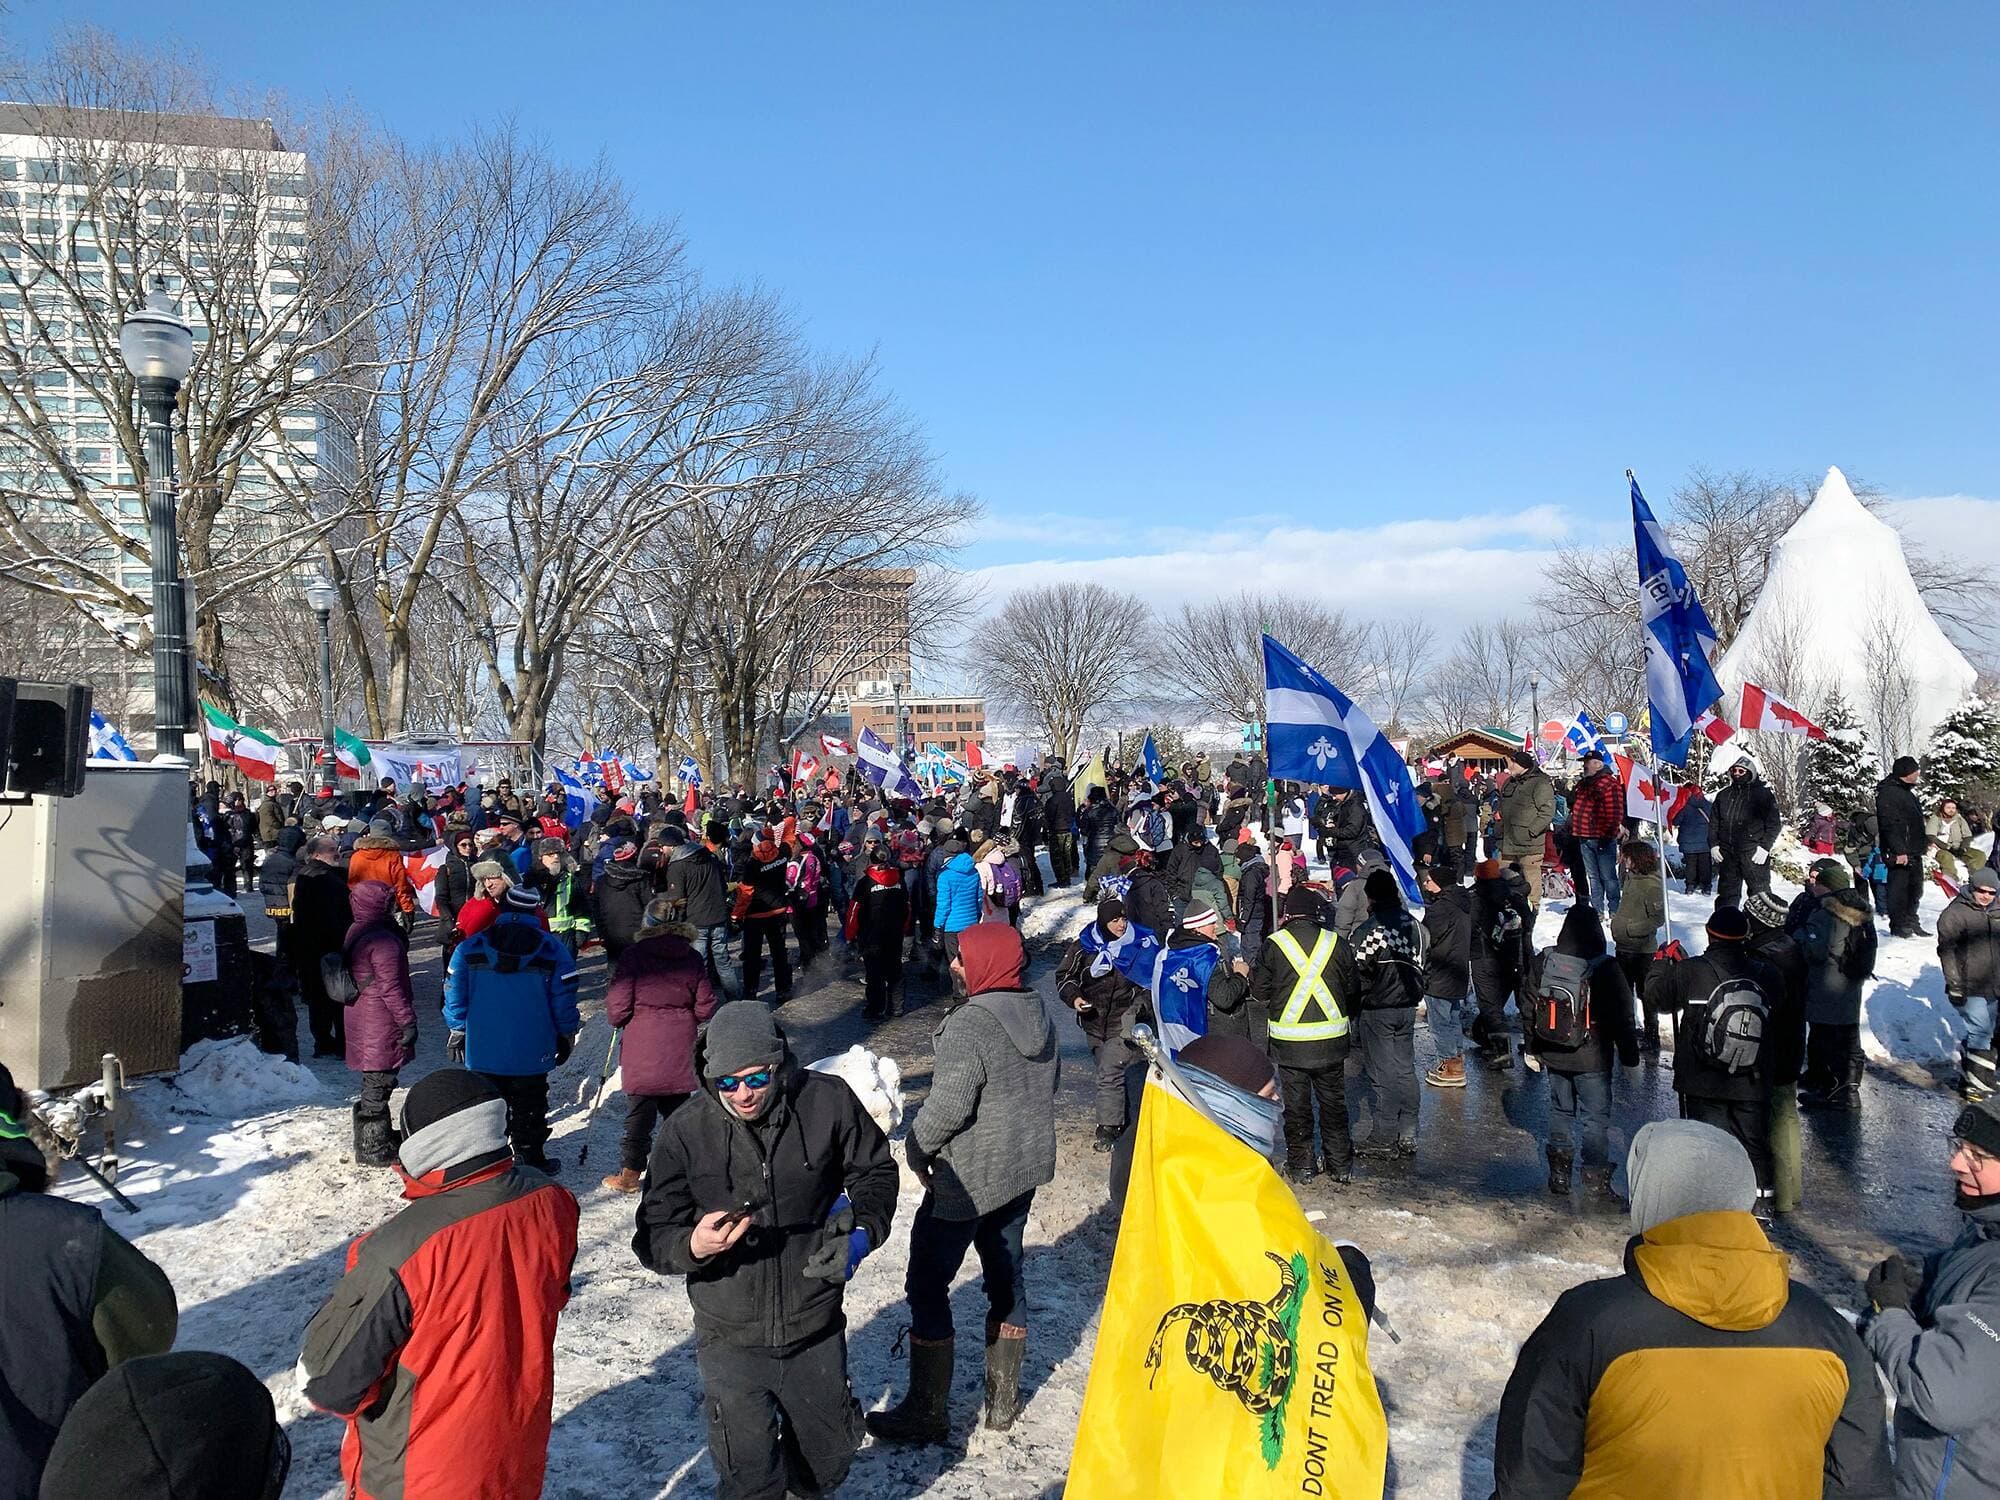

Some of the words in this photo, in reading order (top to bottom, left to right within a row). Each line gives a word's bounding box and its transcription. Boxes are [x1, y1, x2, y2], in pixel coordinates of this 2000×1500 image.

[1320, 1263, 1342, 1291] ME
[1322, 1293, 1343, 1327] ON
[1311, 1342, 1339, 1418] TREAD
[1303, 1427, 1328, 1497] DONT
